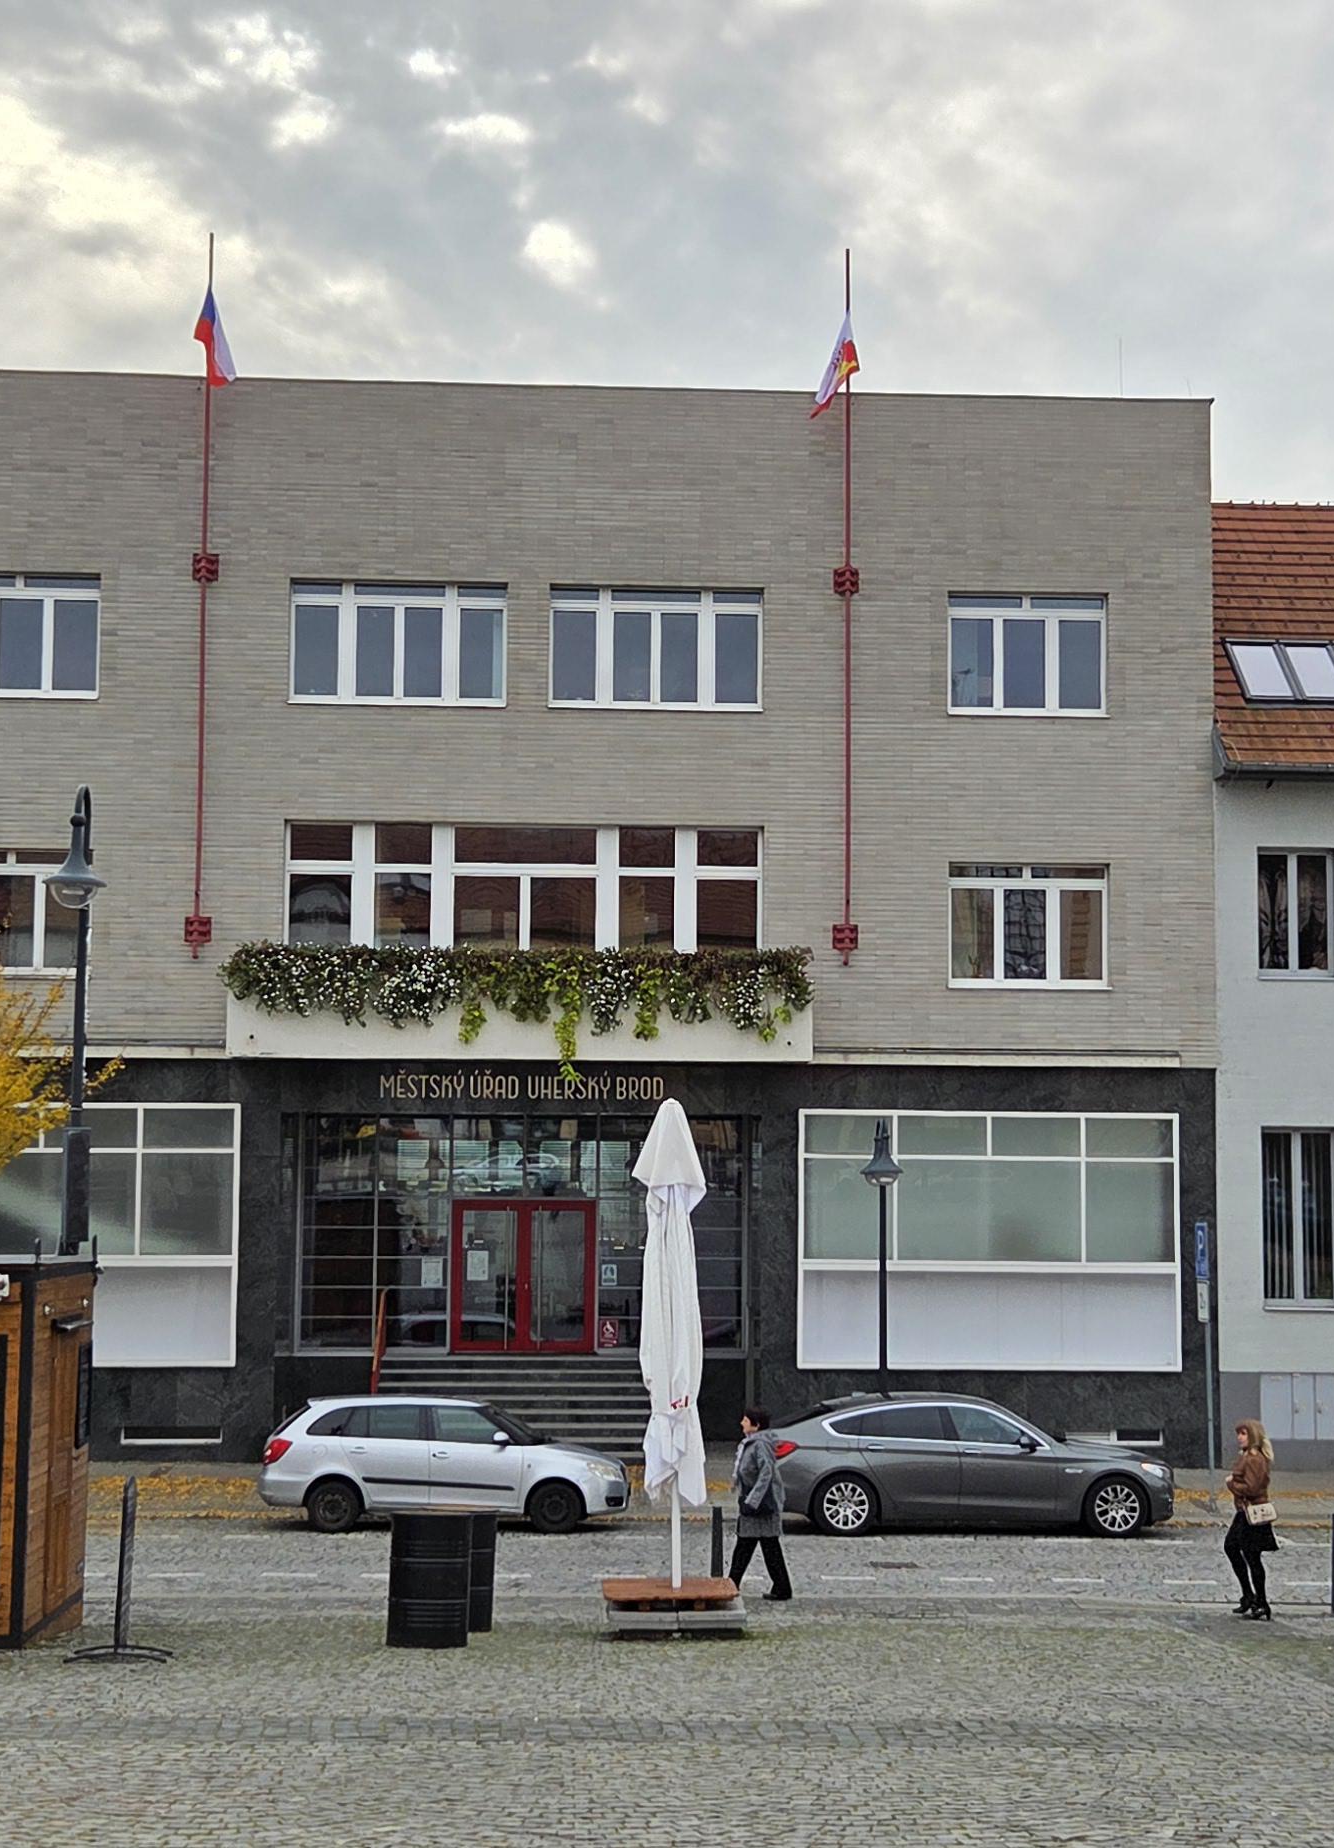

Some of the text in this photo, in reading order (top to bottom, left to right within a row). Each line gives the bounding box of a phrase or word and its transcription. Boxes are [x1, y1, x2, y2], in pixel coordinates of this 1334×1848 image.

[379, 1069, 664, 1100] MĚSTSKÝ ÚŘAD UHERSKÝ BROD
